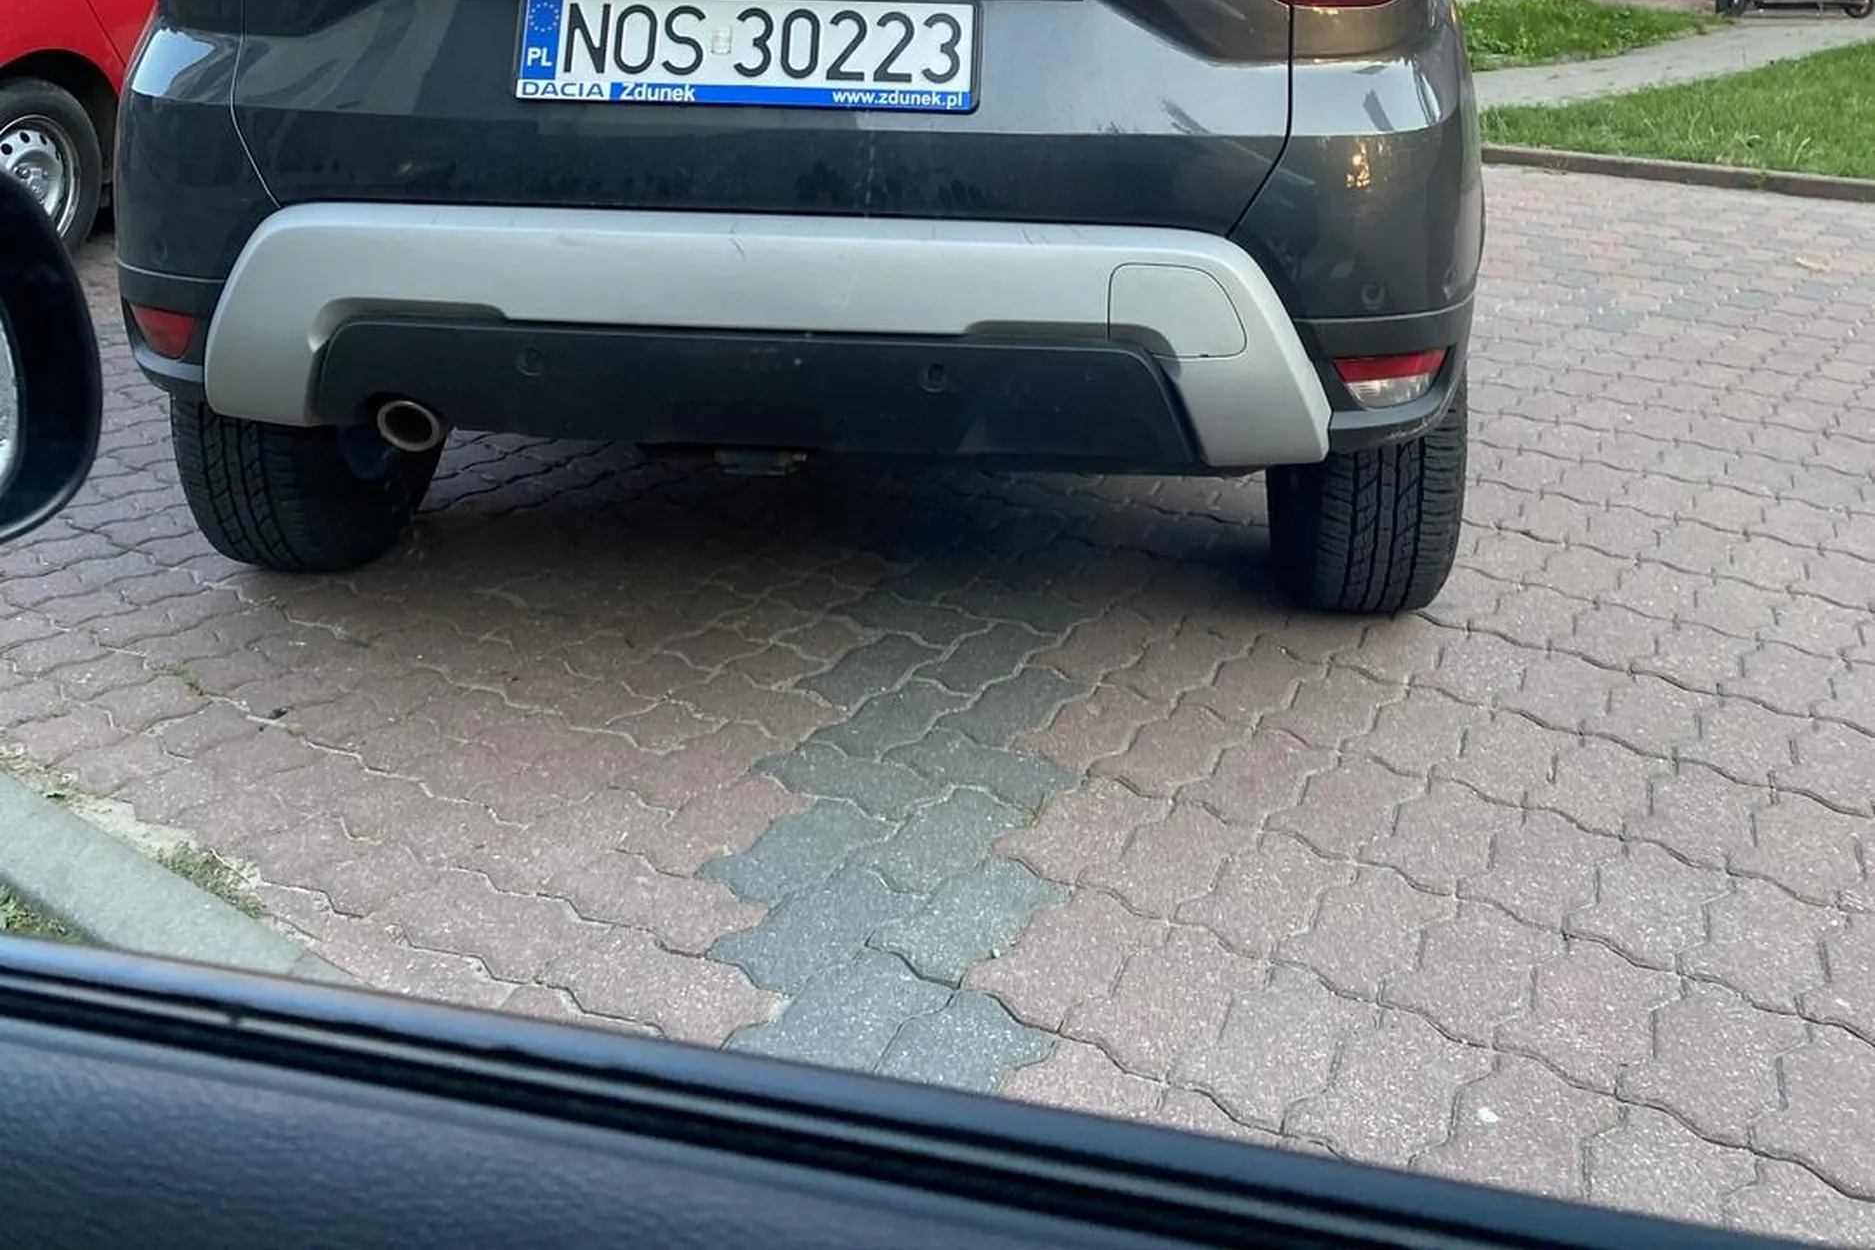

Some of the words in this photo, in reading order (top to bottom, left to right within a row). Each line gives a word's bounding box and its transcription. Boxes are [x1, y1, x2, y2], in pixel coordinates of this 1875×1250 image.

[526, 48, 552, 67] PL
[562, 2, 707, 75] NOS
[733, 8, 962, 84] 30223
[521, 81, 605, 98] DACIA
[620, 82, 696, 102] Zdunek
[832, 90, 963, 110] www.zdunek.pl
